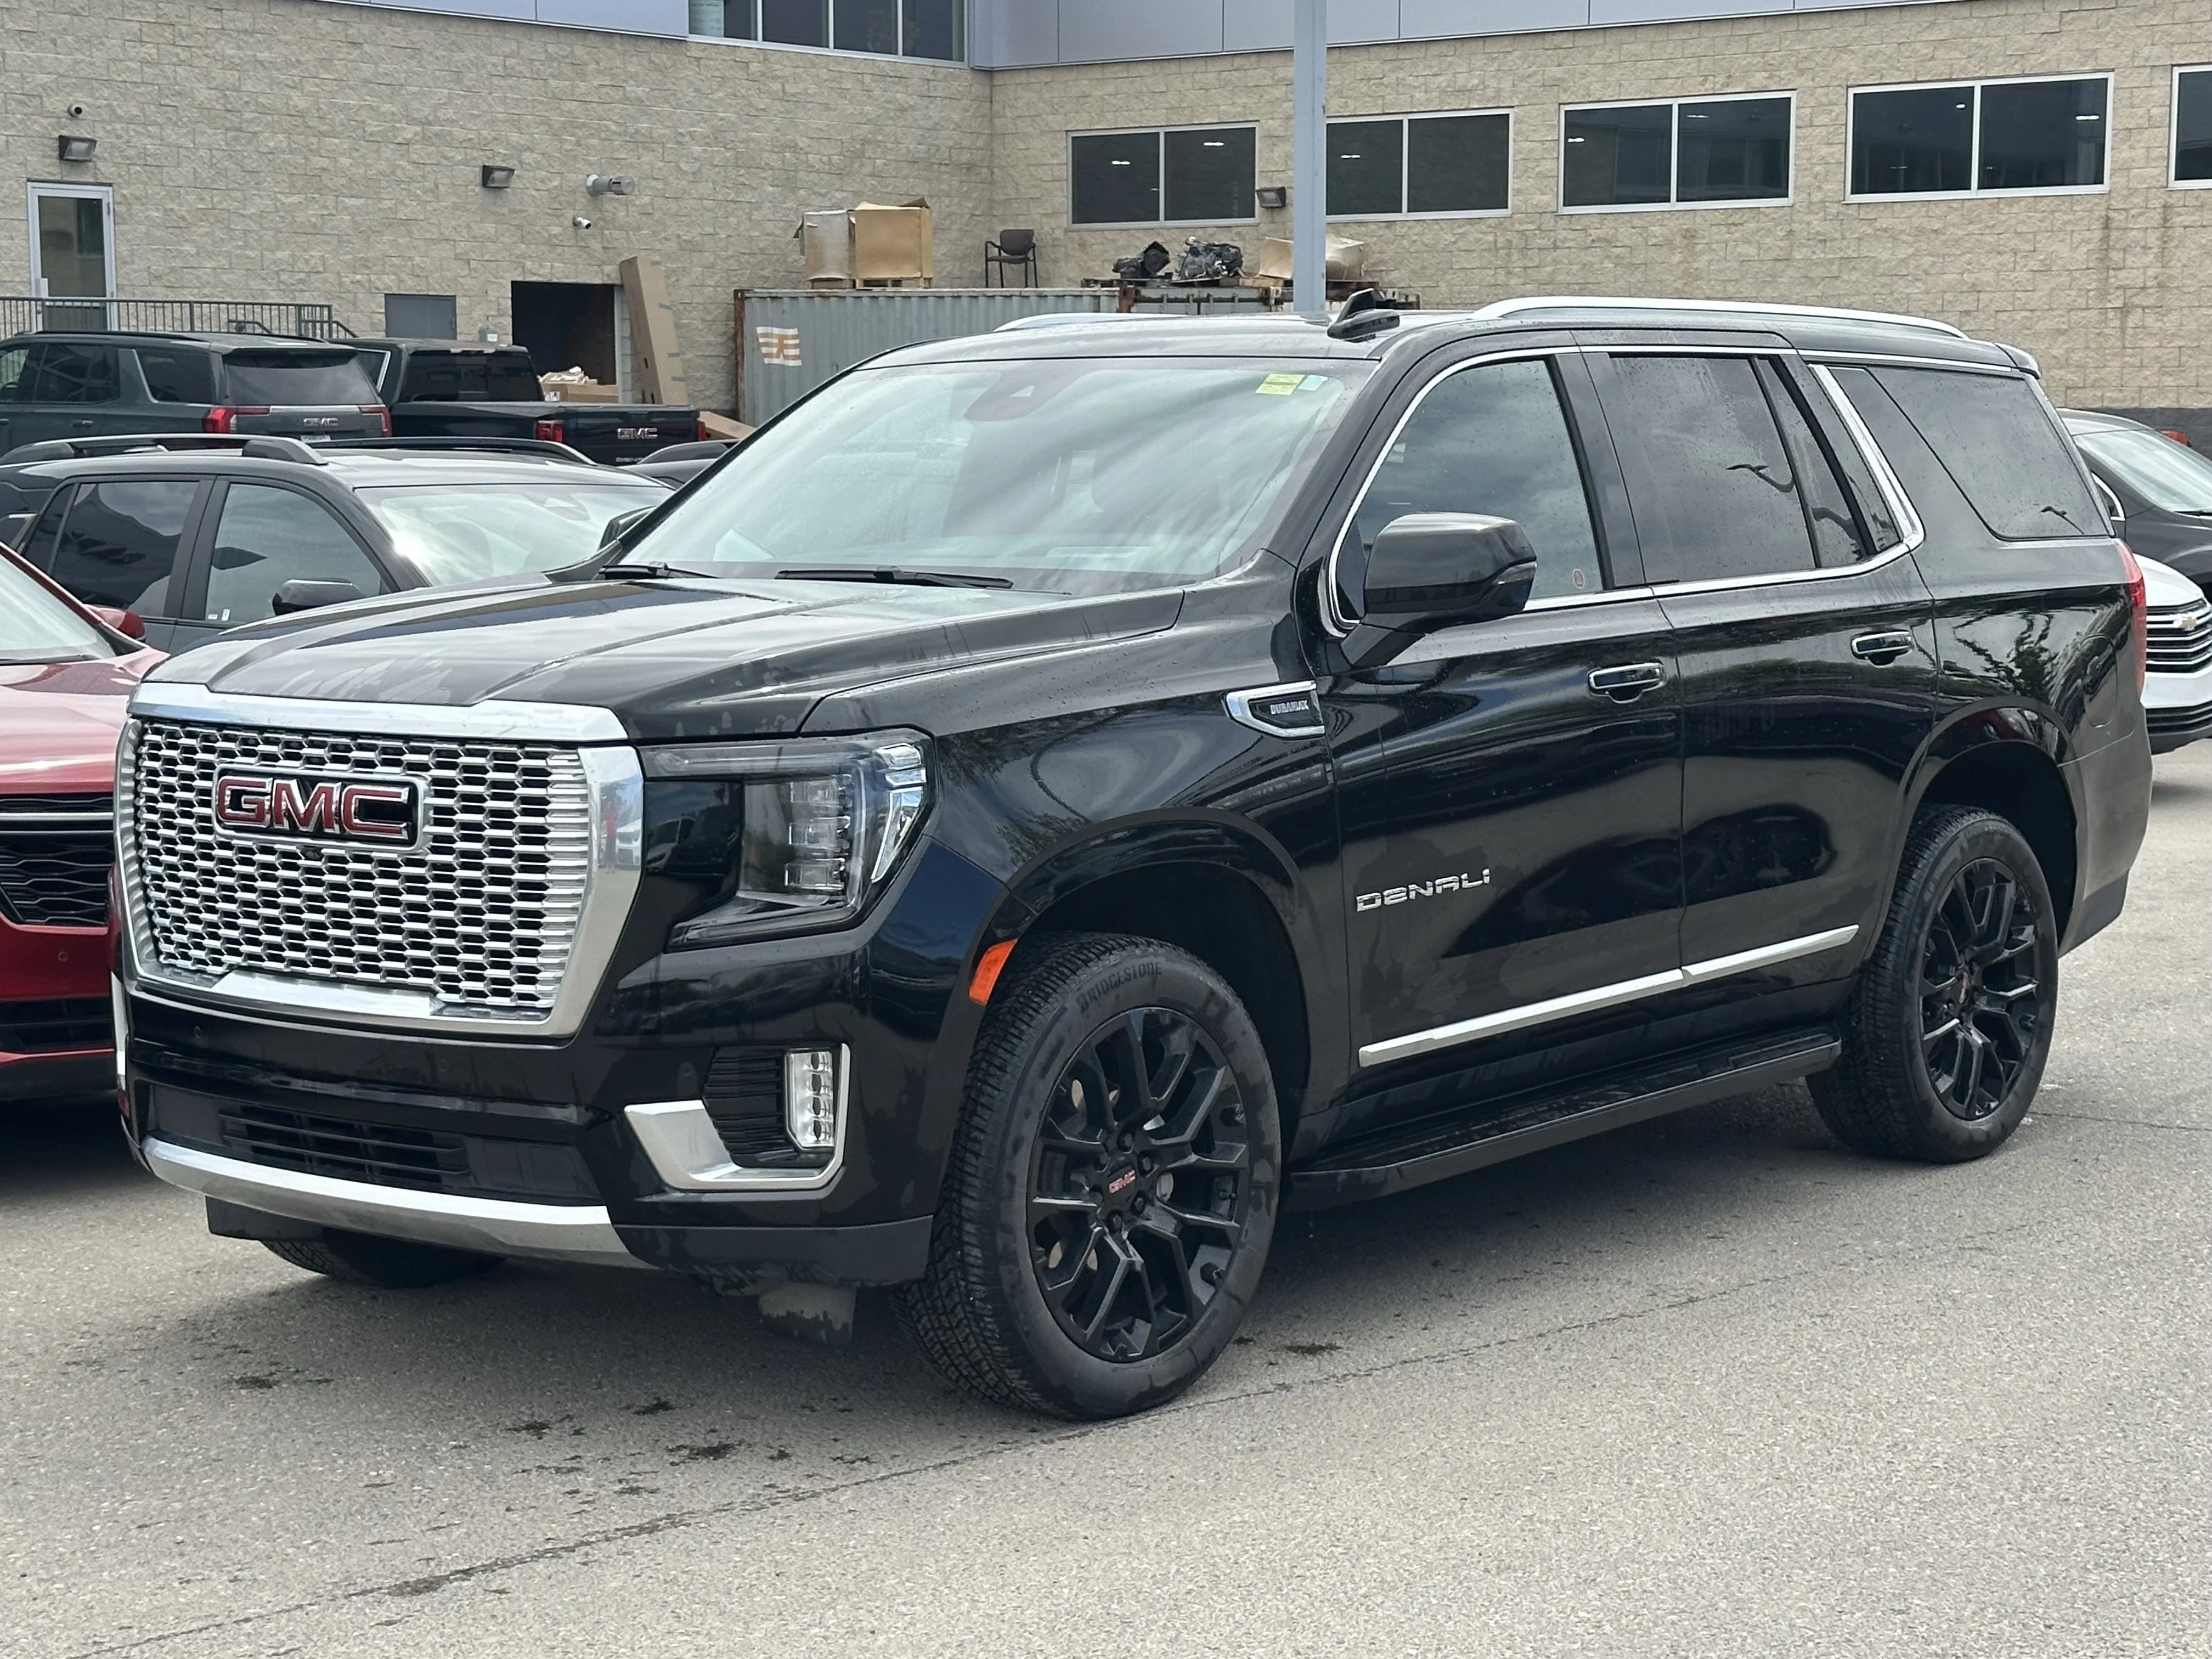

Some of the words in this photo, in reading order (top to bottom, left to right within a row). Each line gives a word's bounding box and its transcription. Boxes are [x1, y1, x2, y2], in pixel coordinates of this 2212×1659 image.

[617, 428, 658, 439] GMC
[1270, 700, 1309, 714] DURAMAX
[217, 775, 409, 839] GMC
[1356, 868, 1490, 912] DENALI
[1076, 962, 1162, 1014] BRIDGESTONE
[1109, 1170, 1136, 1193] GMC
